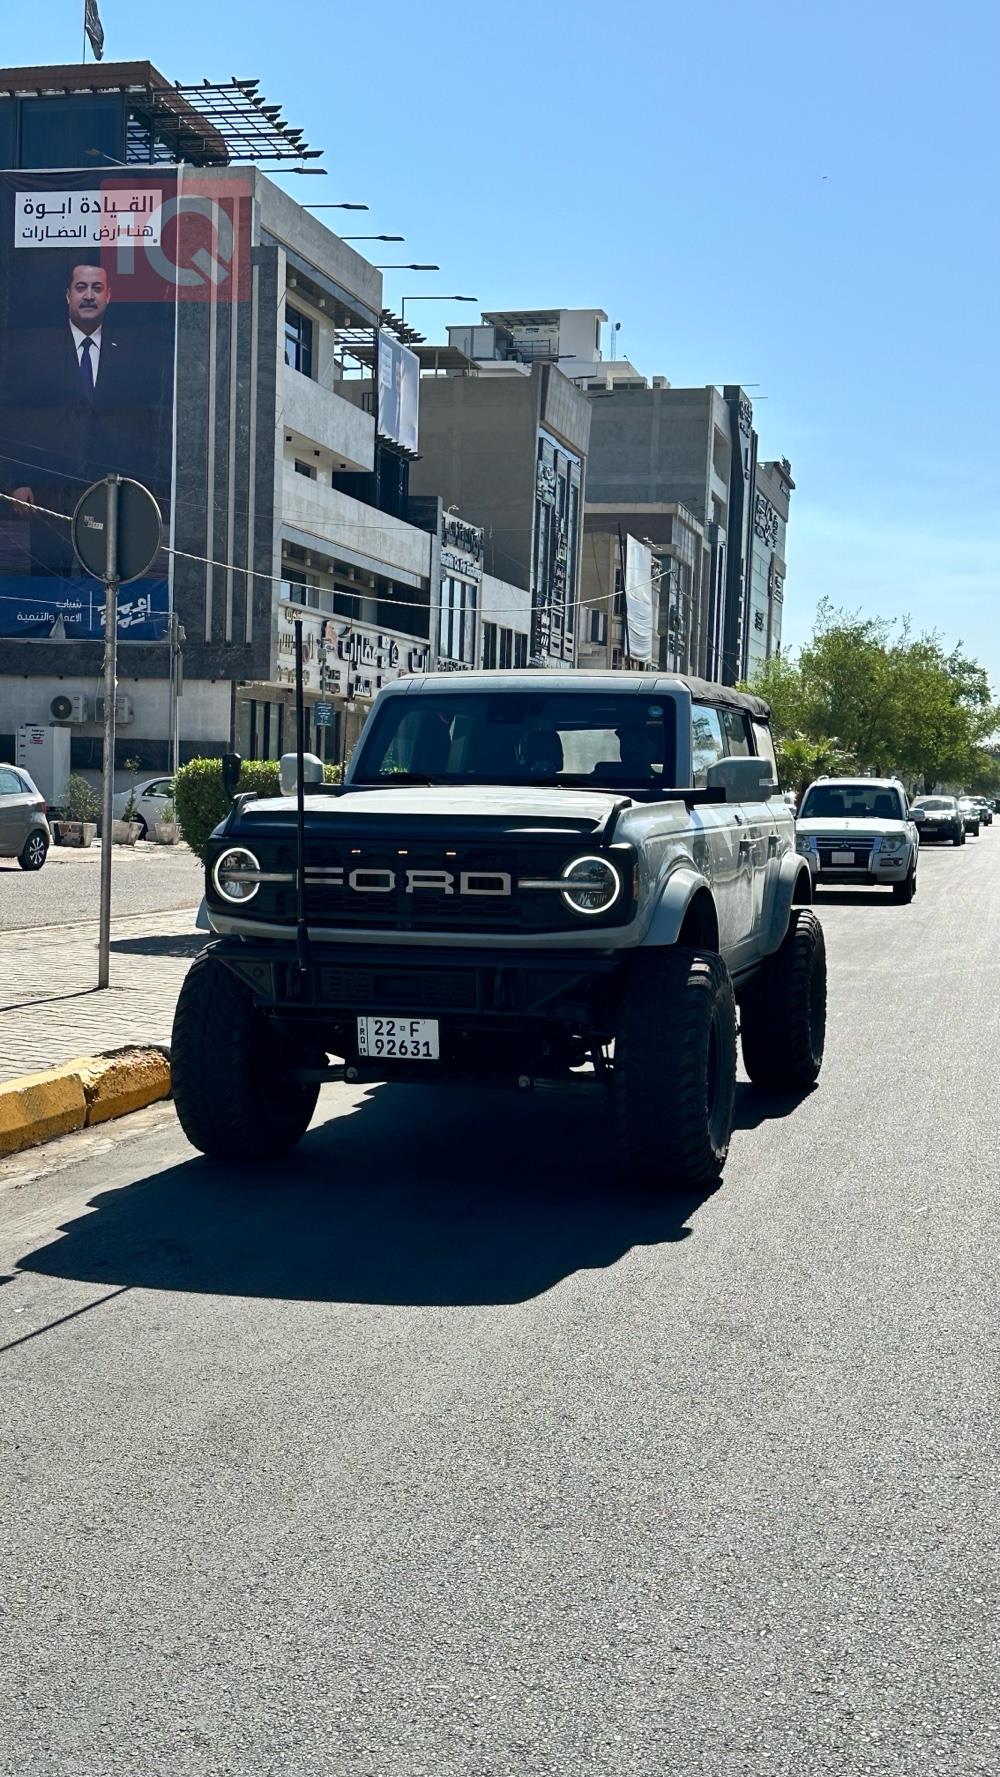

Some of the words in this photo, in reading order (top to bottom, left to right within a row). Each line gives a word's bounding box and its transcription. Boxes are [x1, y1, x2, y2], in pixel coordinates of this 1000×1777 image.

[23, 197, 72, 219] ابوة
[80, 195, 154, 219] القيادة
[22, 225, 87, 242] الحضارات
[92, 224, 121, 241] ارض
[126, 224, 154, 238] هنا
[296, 866, 512, 895] FORD
[374, 1019, 397, 1037] 22
[409, 1021, 421, 1038] F
[374, 1038, 433, 1058] 92631
